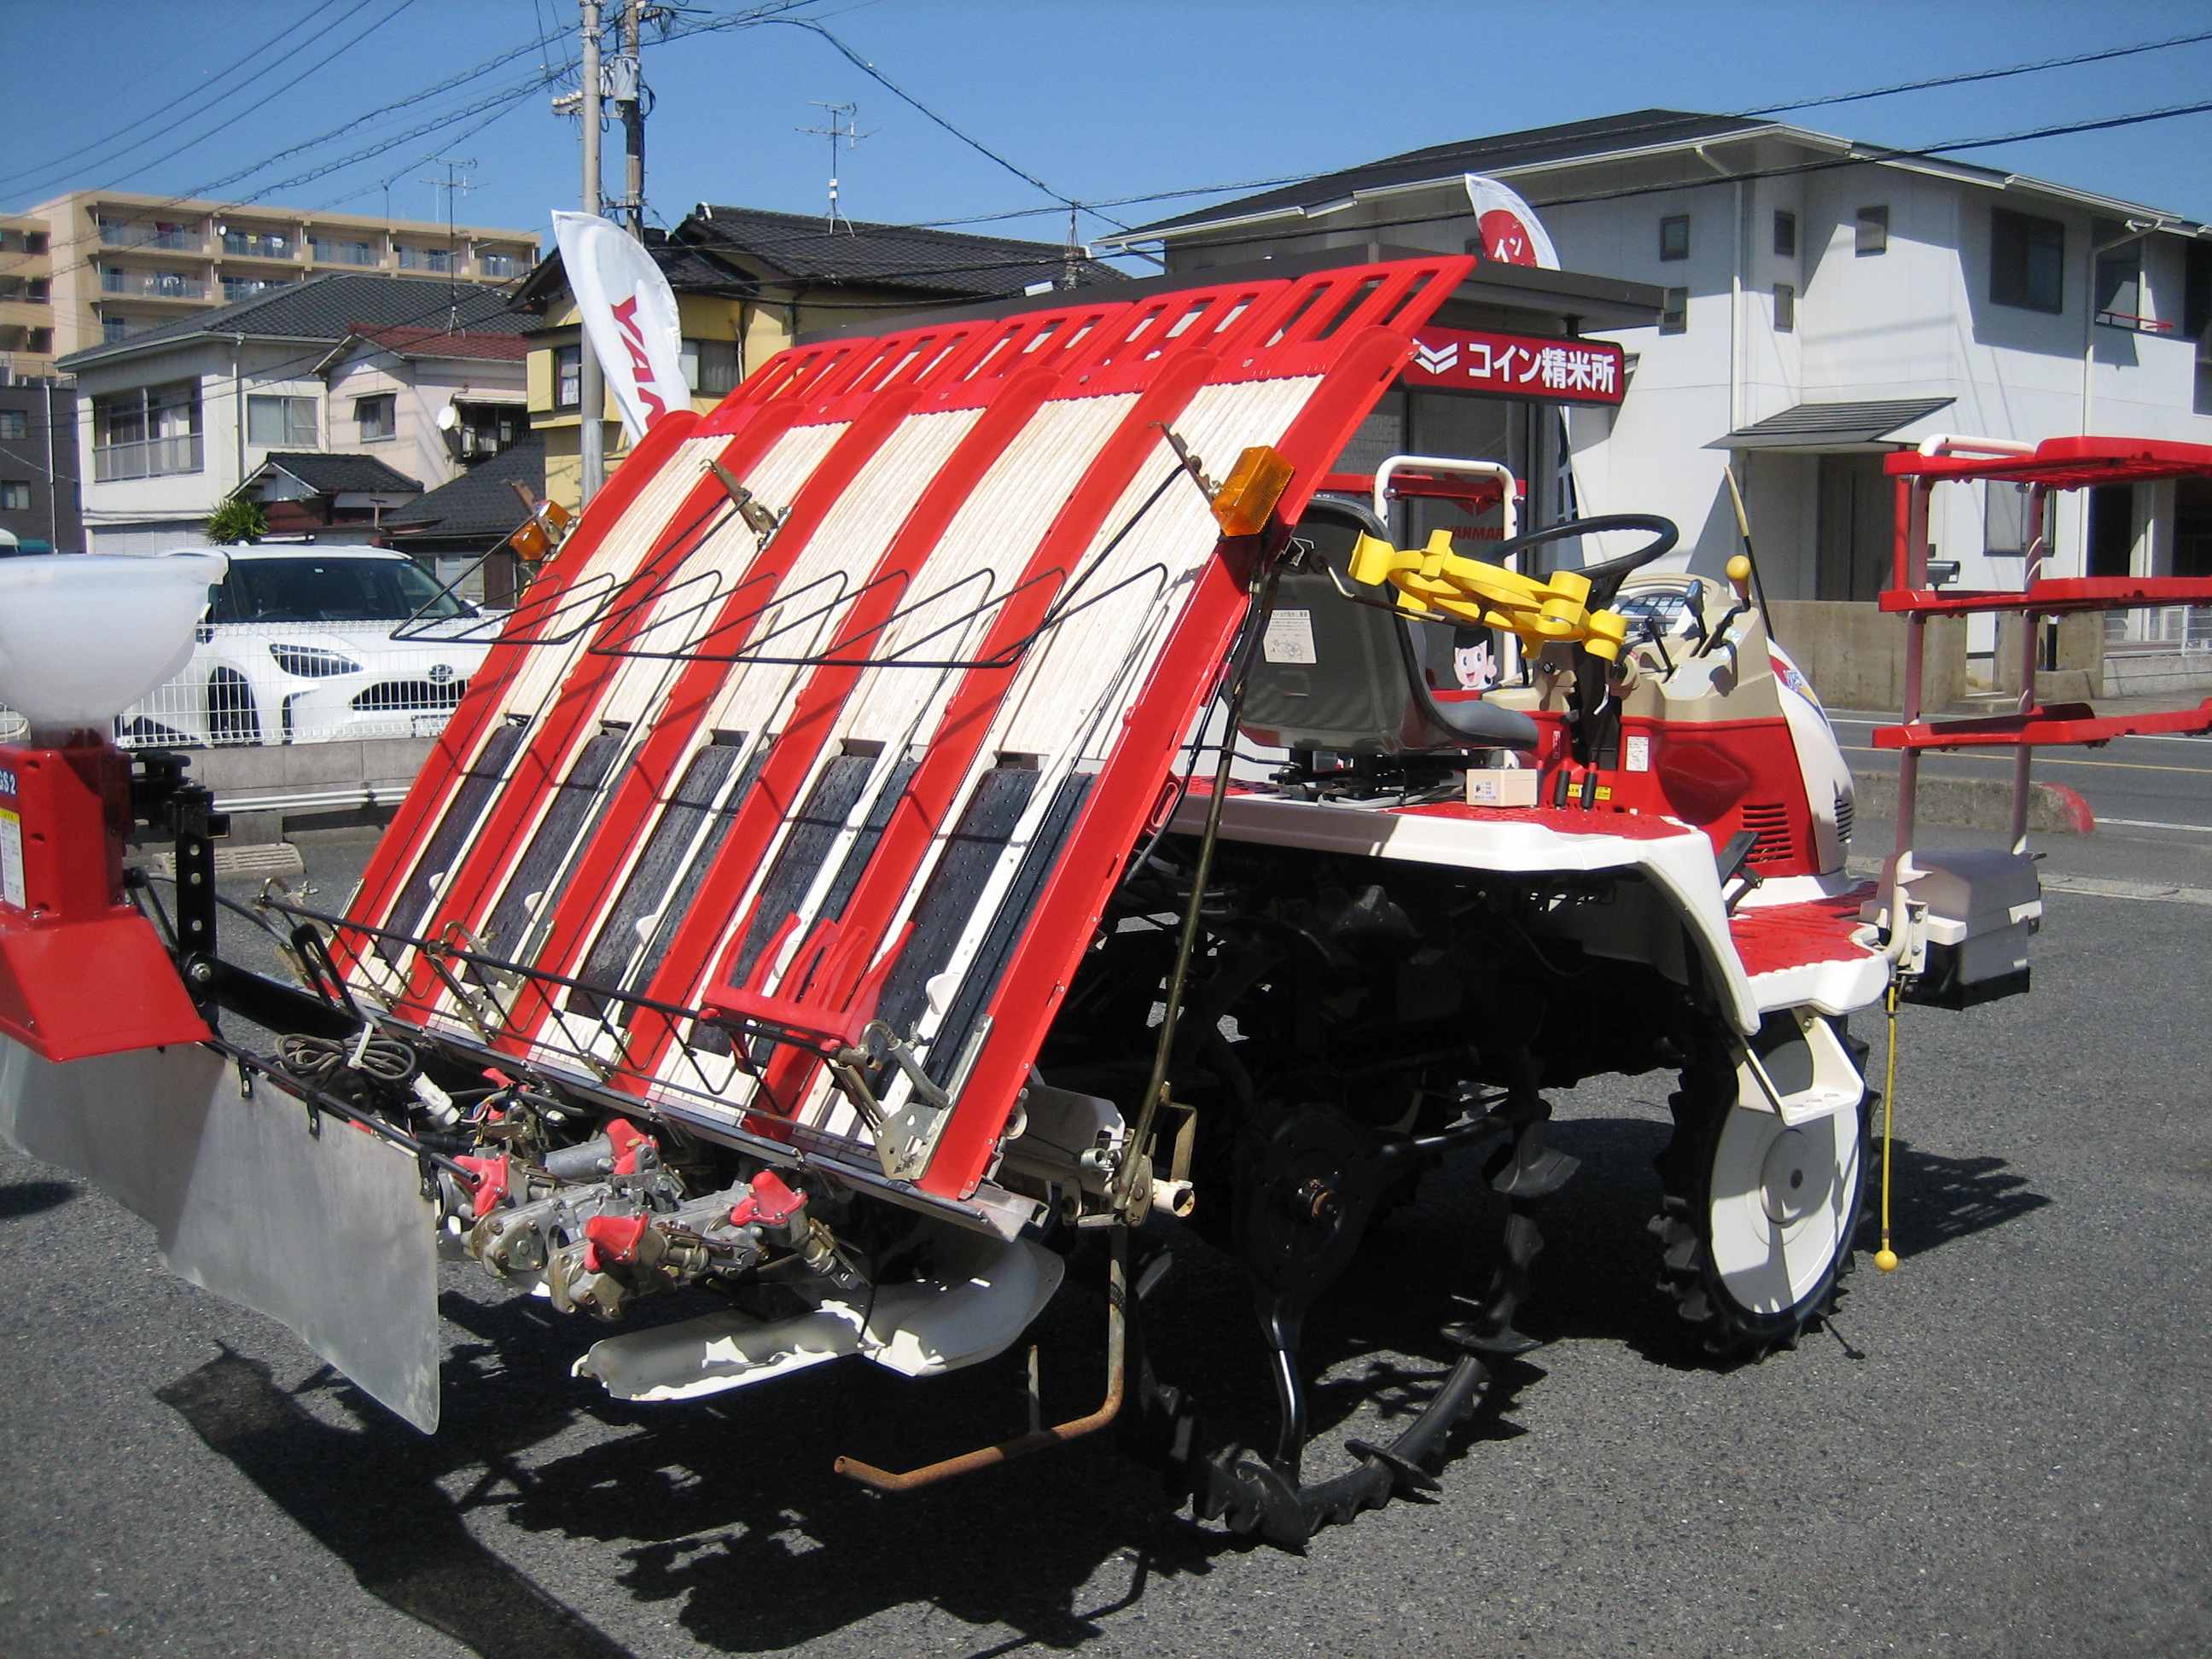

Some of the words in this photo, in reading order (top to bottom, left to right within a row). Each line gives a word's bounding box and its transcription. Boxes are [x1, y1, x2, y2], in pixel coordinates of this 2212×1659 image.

[1469, 342, 1615, 393] コイン精米所
